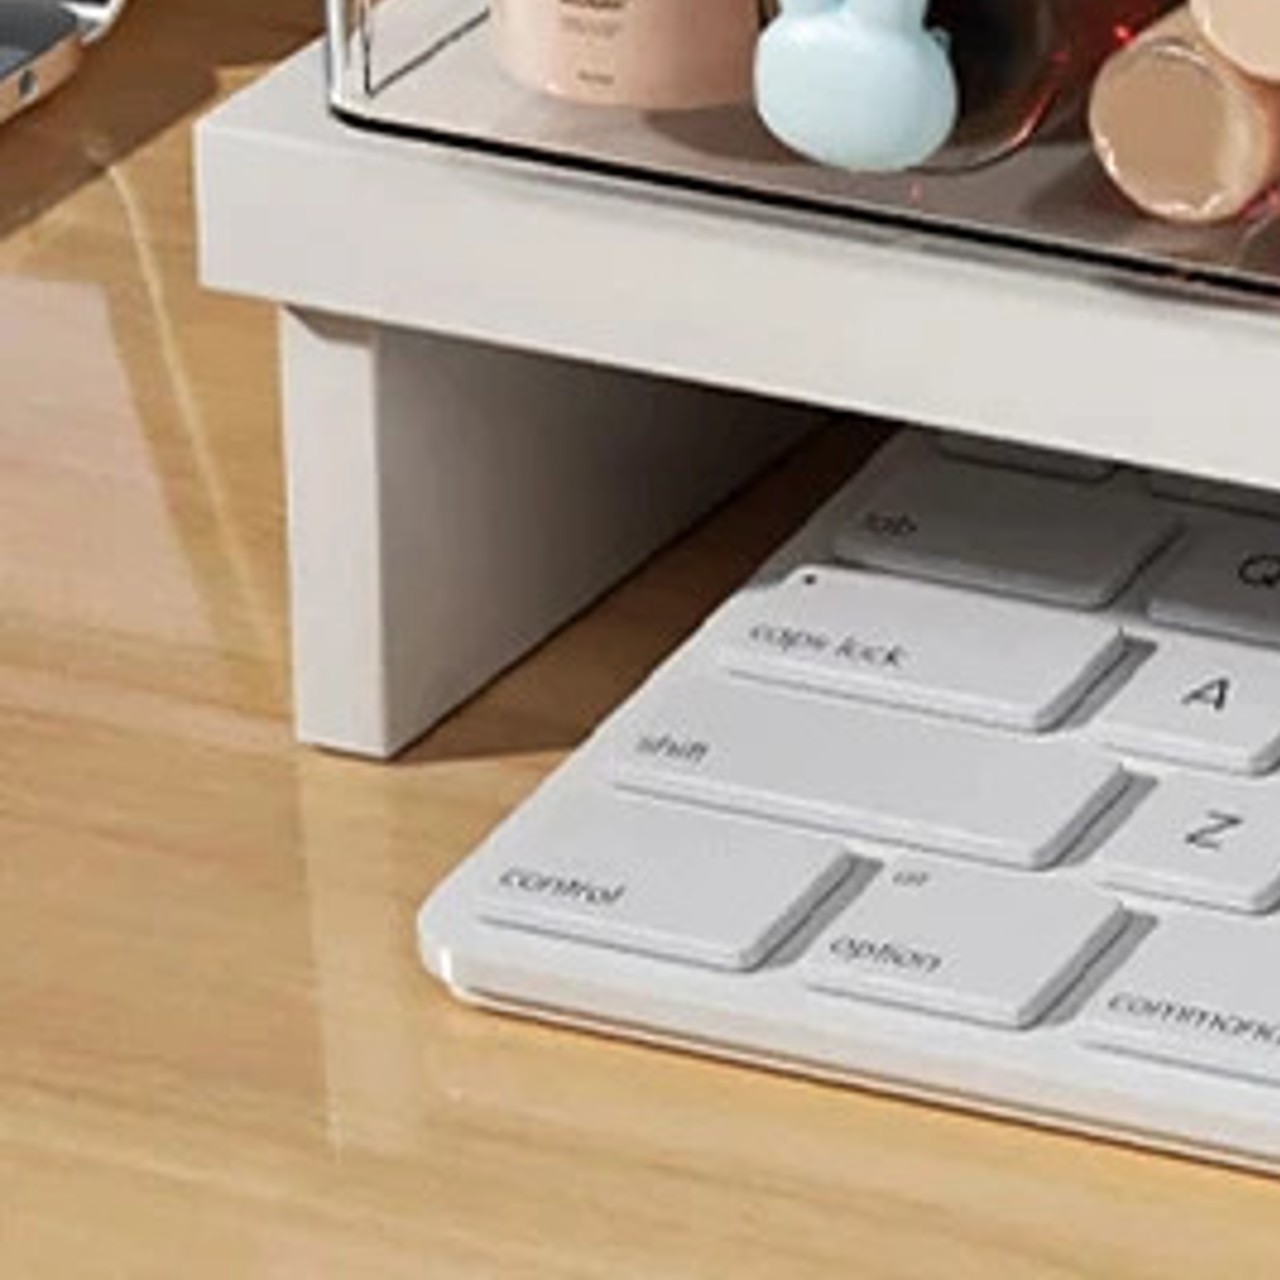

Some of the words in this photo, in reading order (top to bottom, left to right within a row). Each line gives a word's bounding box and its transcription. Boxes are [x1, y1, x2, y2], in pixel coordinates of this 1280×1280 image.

[839, 636, 904, 668] lock
[1182, 677, 1231, 711] A
[637, 735, 709, 764] shift
[1184, 811, 1244, 850] Z
[499, 866, 626, 906] control
[828, 933, 943, 974] option
